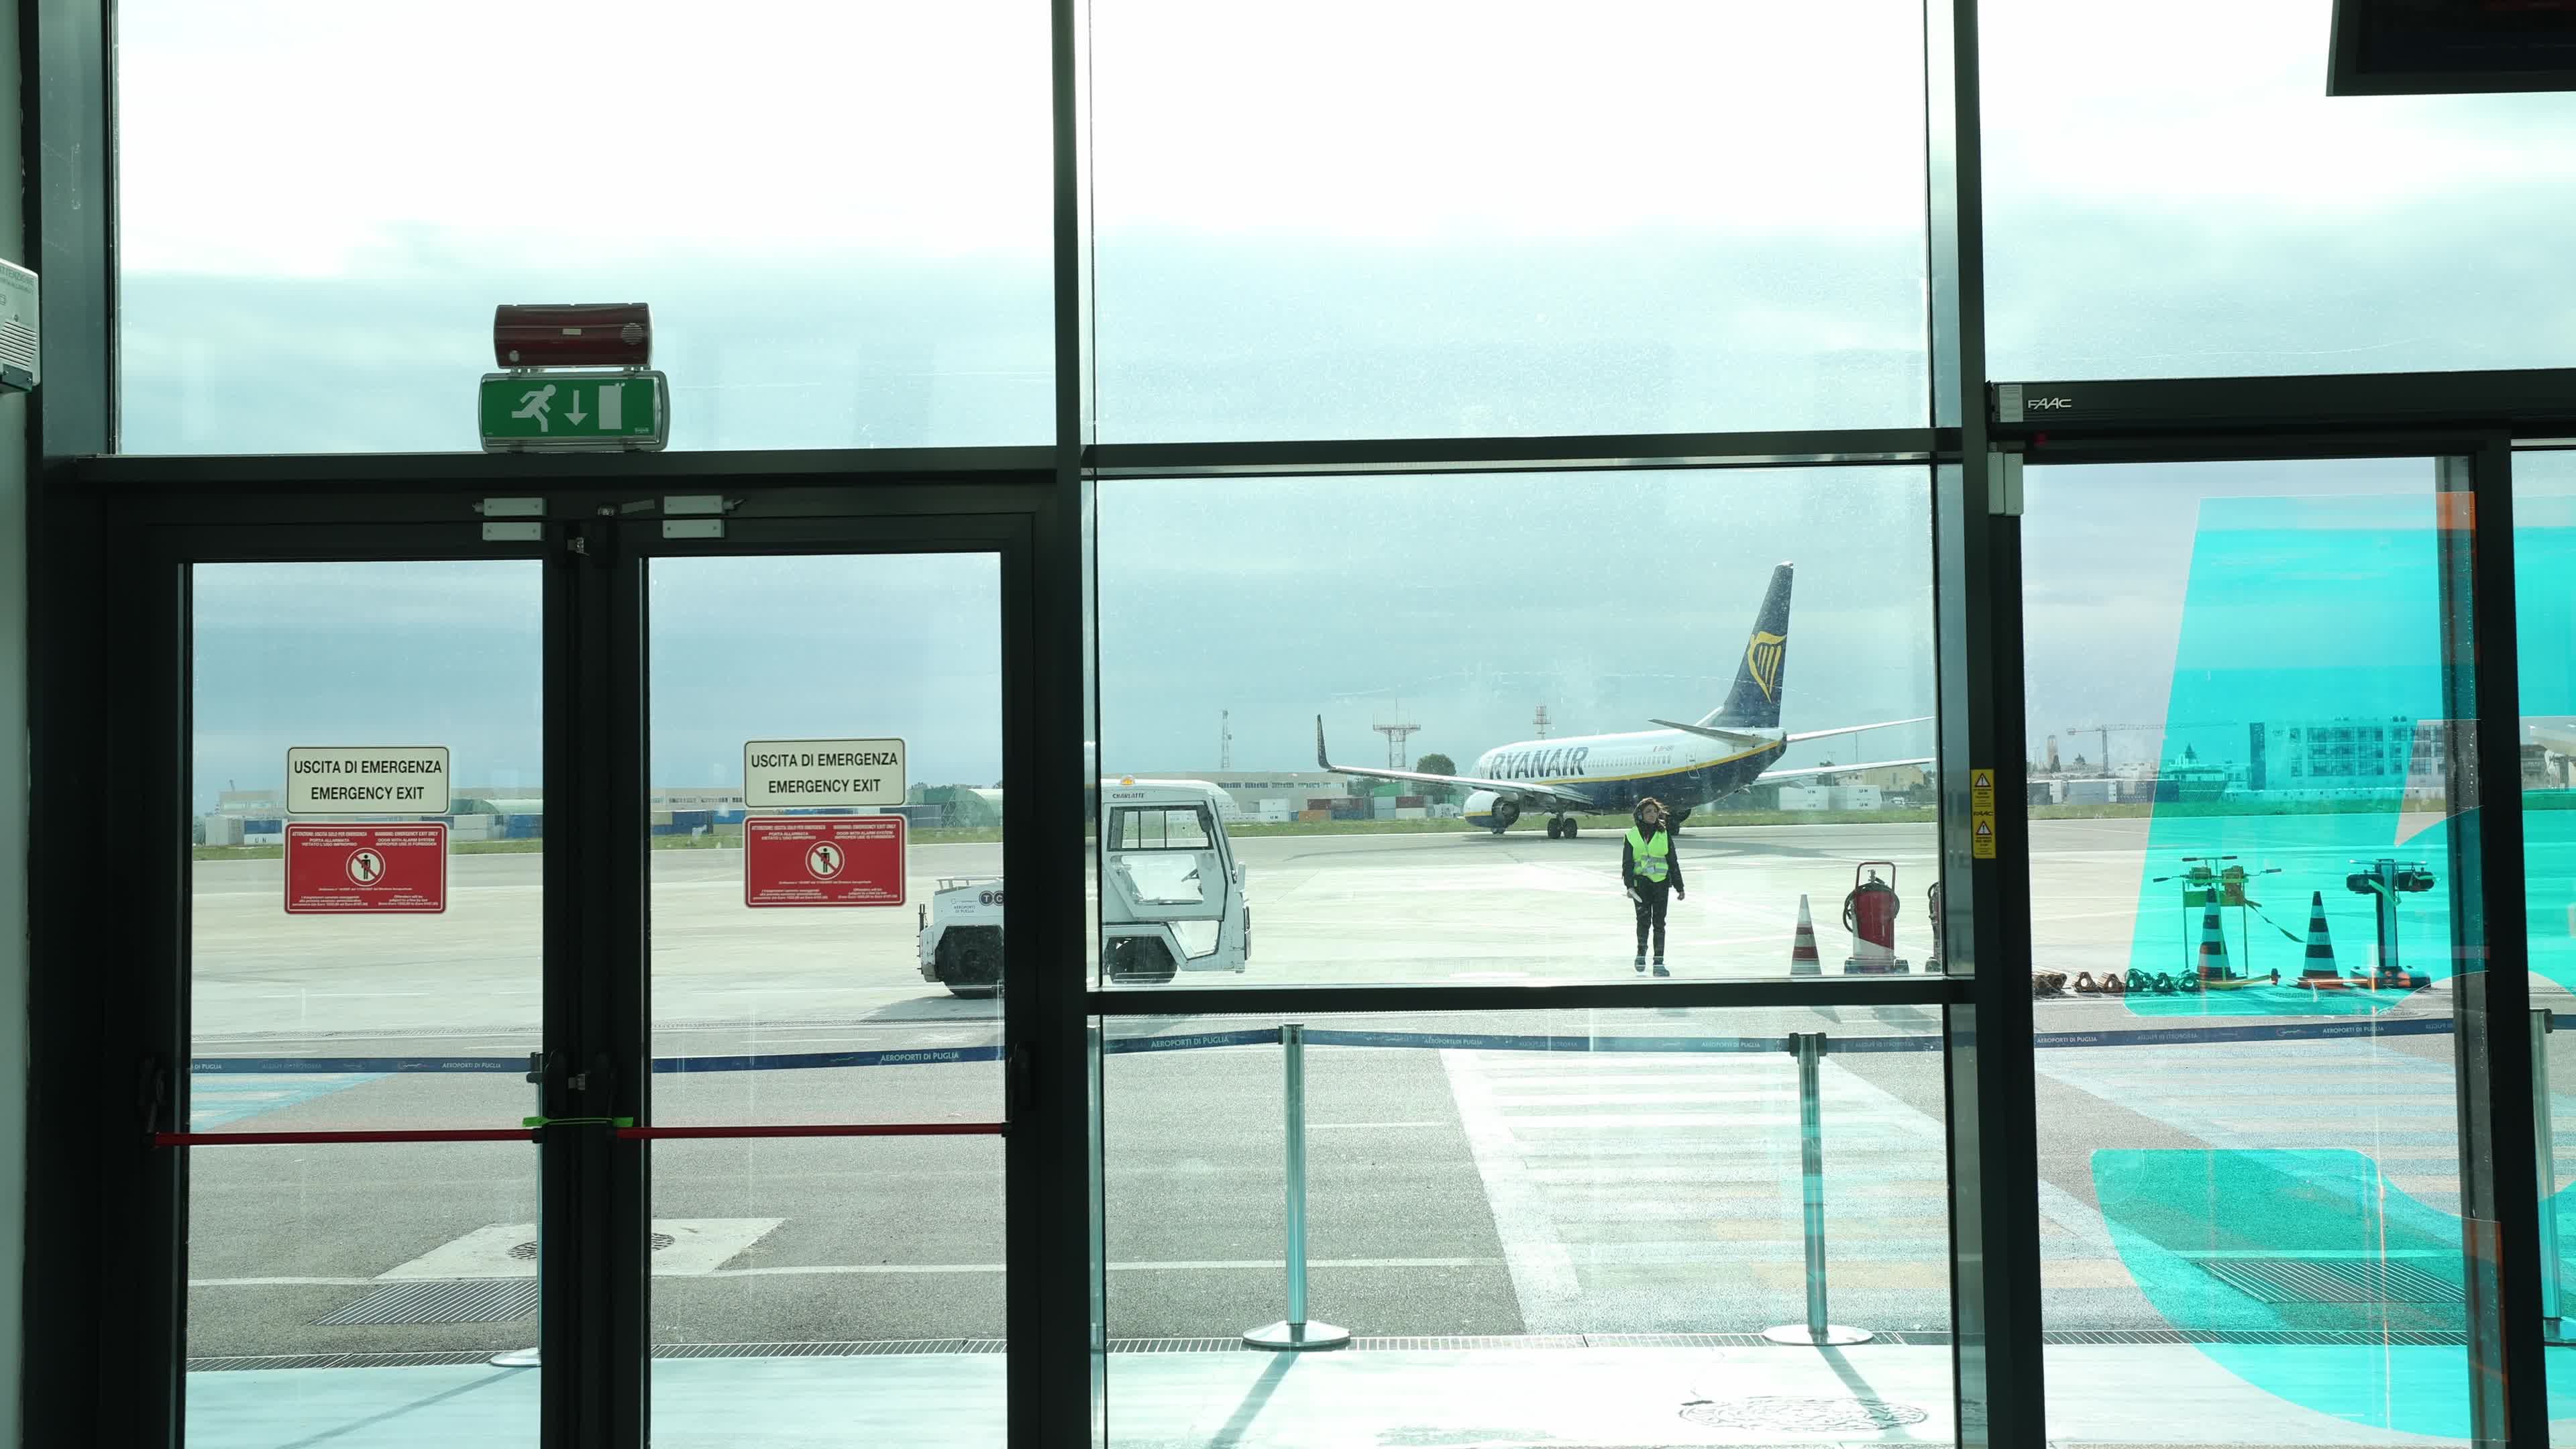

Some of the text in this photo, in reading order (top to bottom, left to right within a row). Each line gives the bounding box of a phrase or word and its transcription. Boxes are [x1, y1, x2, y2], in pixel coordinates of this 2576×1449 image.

[2028, 398, 2072, 409] FAAC
[751, 753, 898, 767] USCITA DI EMERGENZA
[1489, 747, 1589, 779] RYANAIR
[294, 761, 442, 773] USCITA DI EMERGENZA
[769, 779, 880, 793] EMERGENCY EXIT
[311, 787, 424, 800] EMERGENCY EXIT
[1151, 1038, 1191, 1048] AEROPORTI
[1203, 1035, 1229, 1044] PUGLIA
[880, 1053, 921, 1062] AEROPORTI
[933, 1051, 959, 1060] PUGLIA
